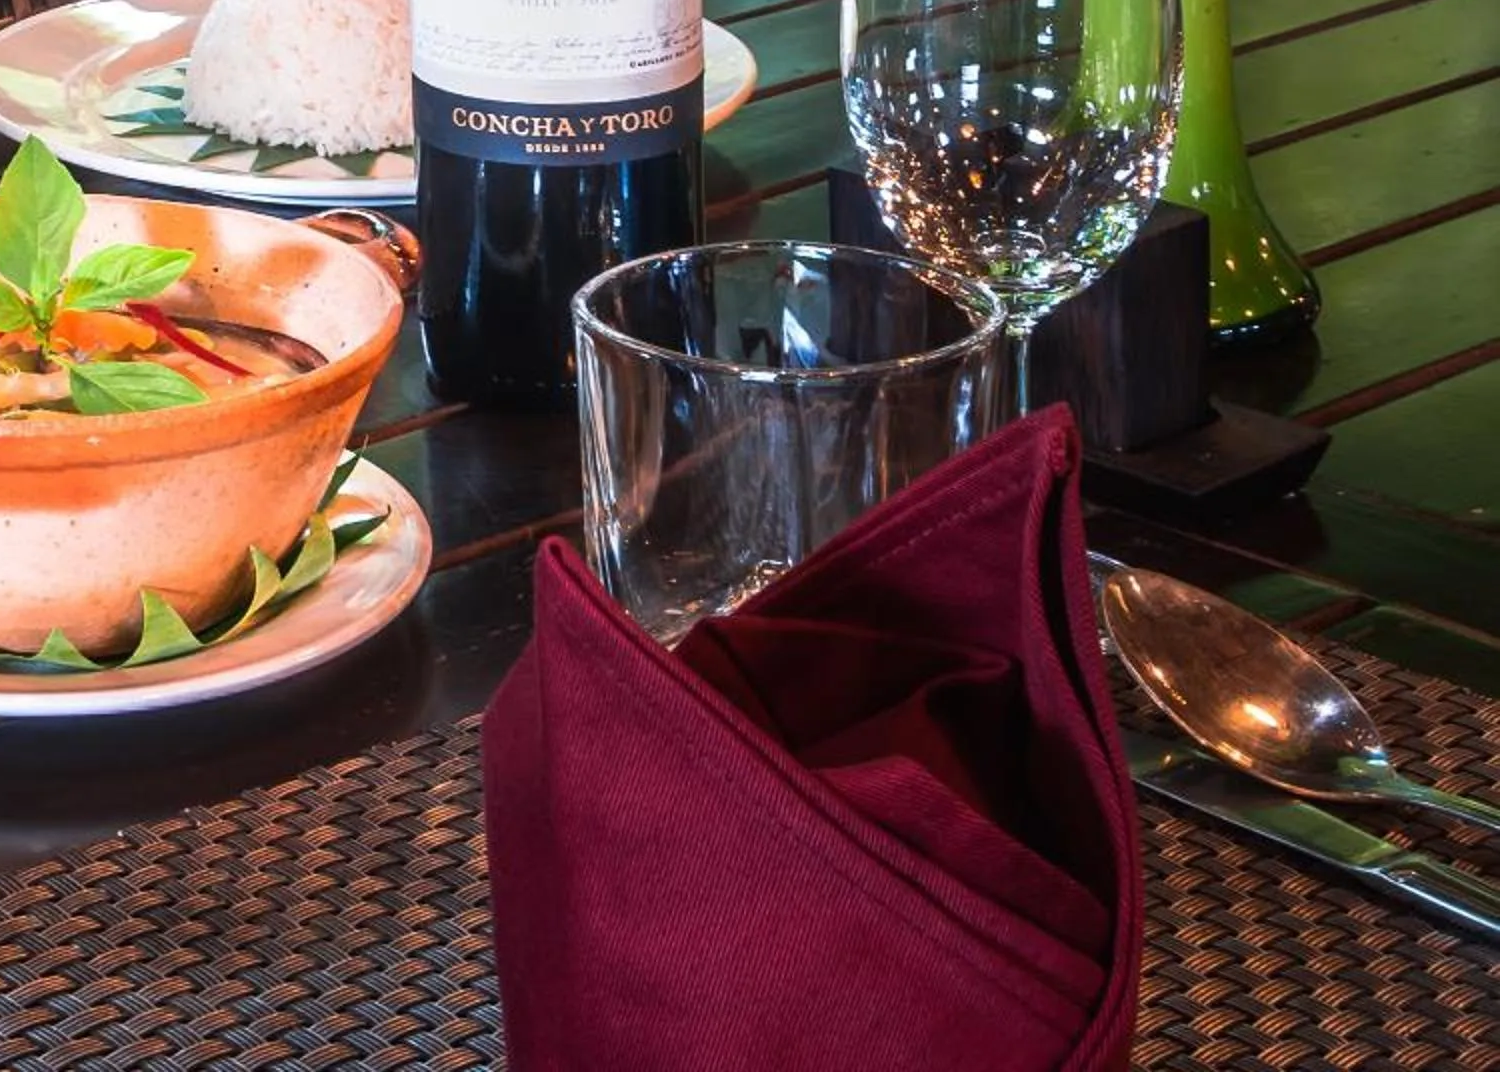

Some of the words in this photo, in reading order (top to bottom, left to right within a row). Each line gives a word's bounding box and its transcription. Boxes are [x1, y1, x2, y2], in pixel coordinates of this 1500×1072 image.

[452, 107, 576, 137] CONCHA
[579, 118, 595, 135] Y
[599, 105, 674, 135] TORO
